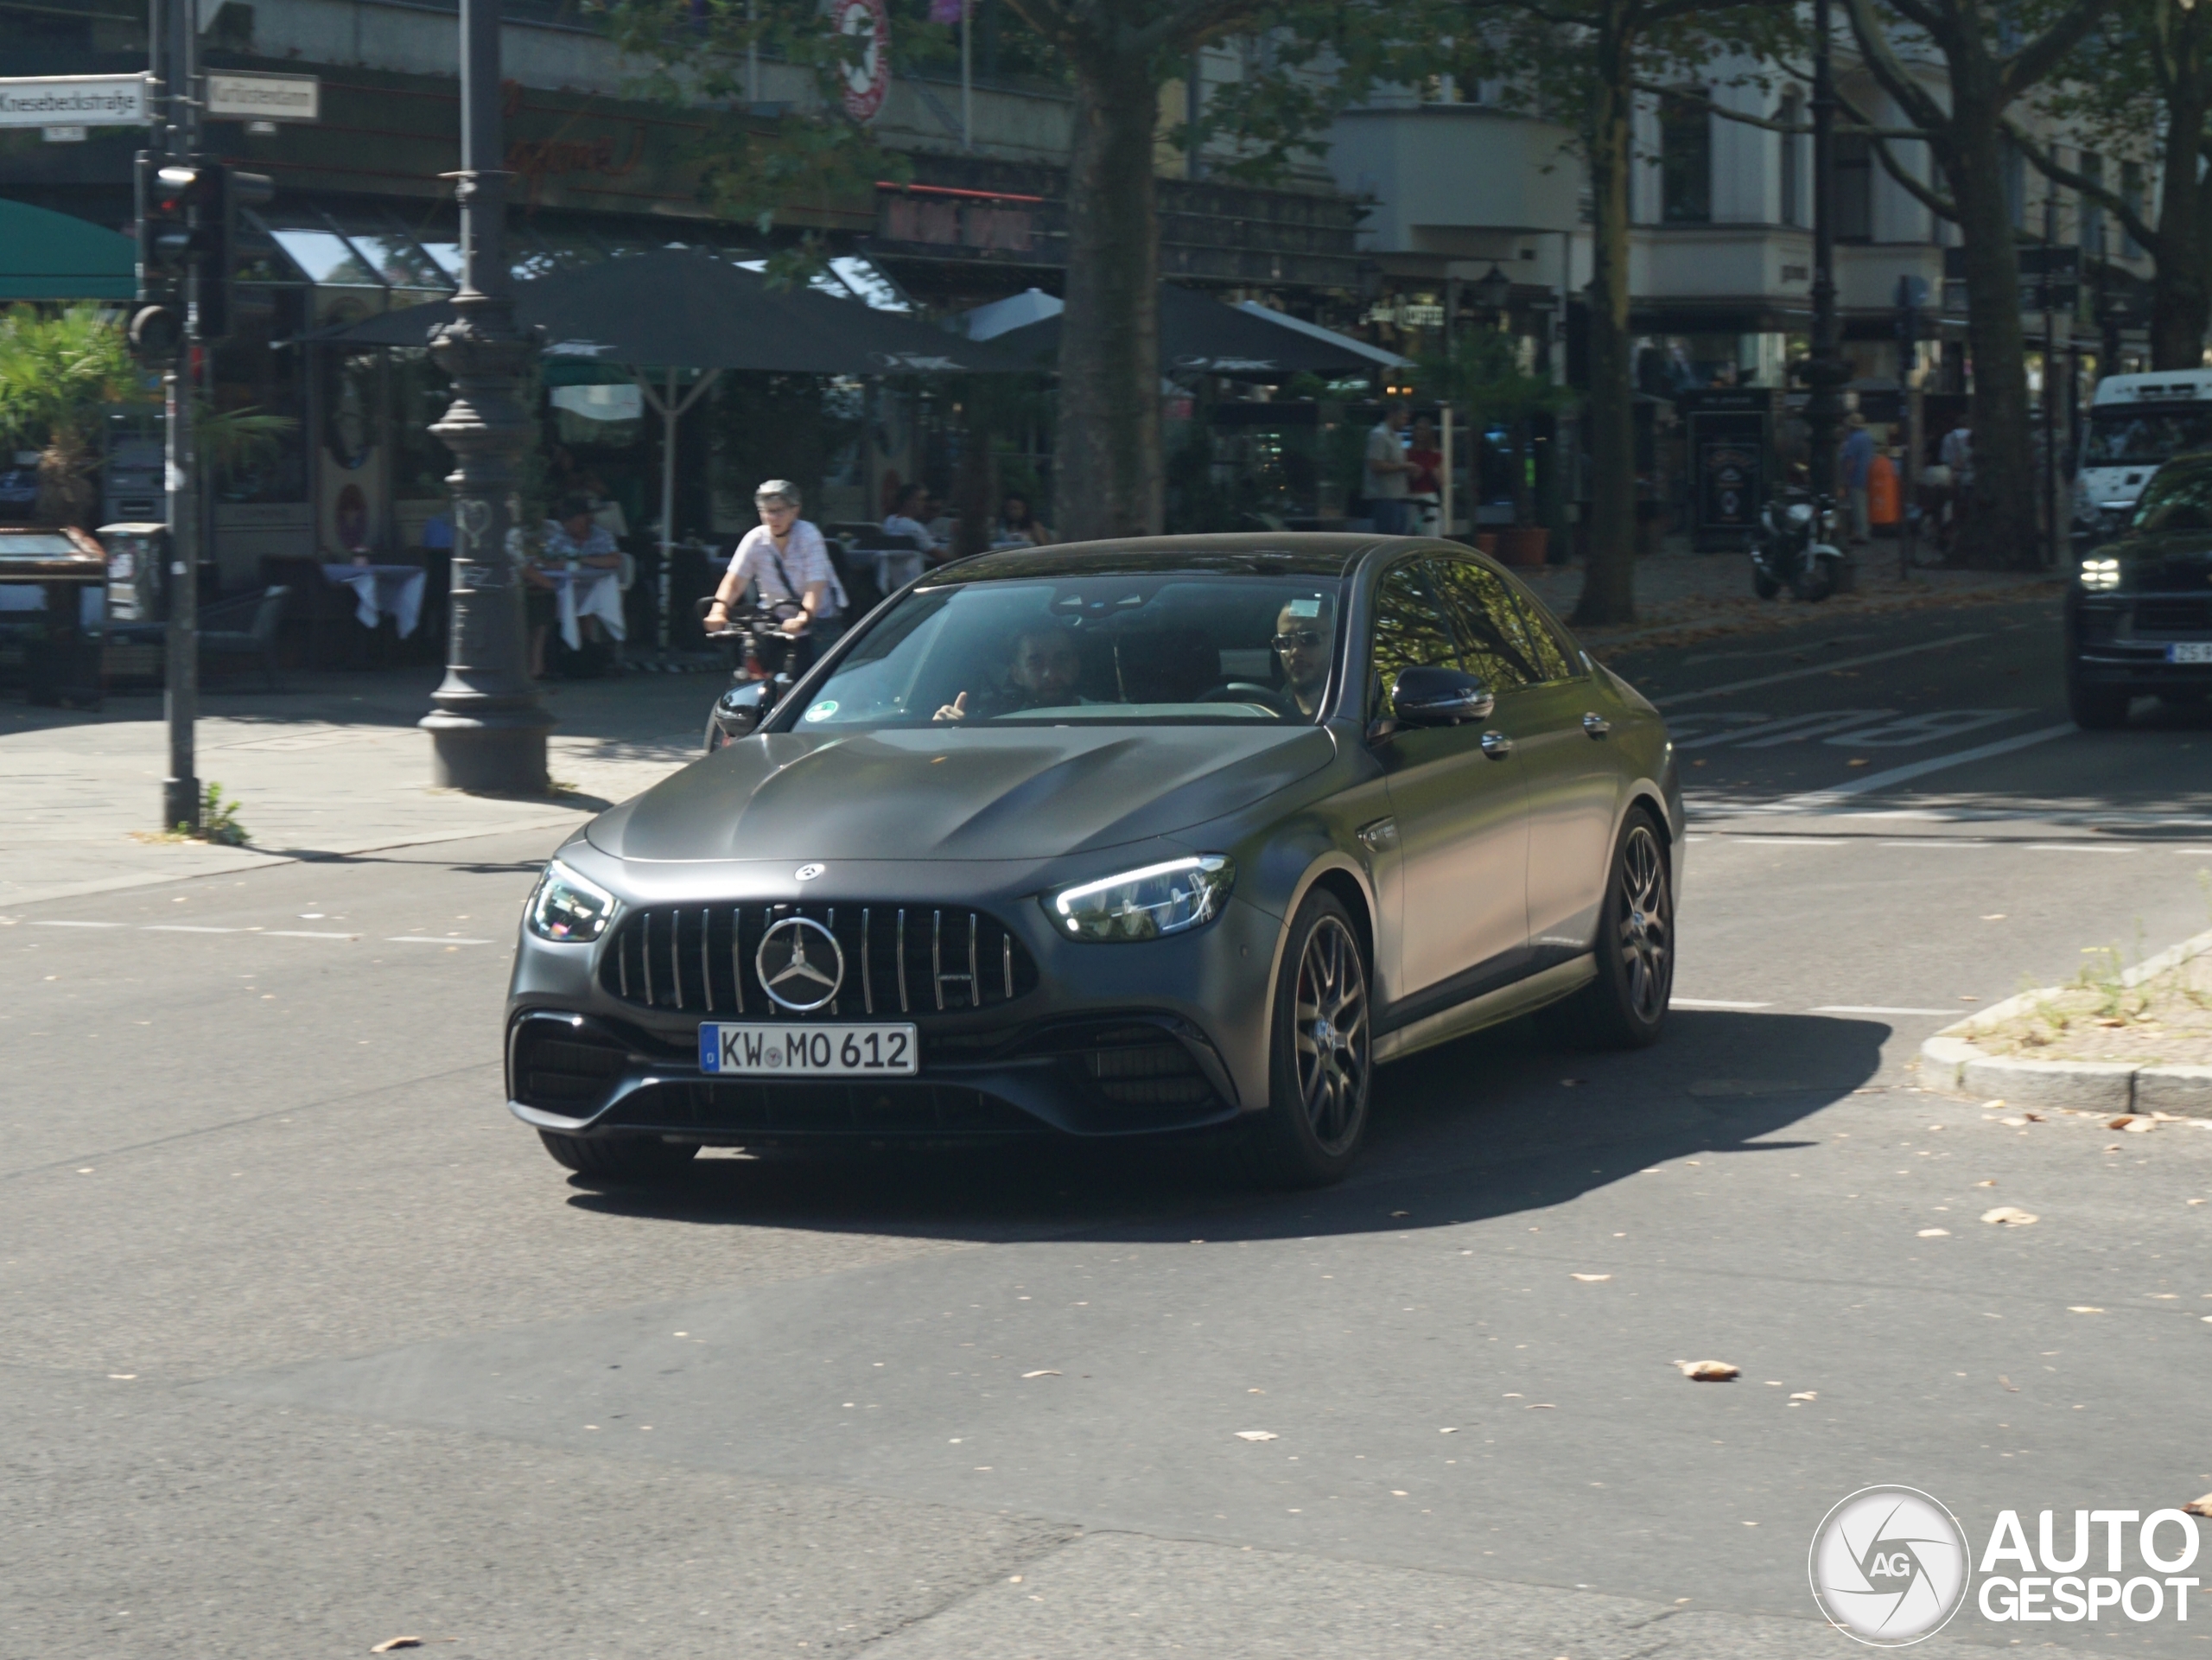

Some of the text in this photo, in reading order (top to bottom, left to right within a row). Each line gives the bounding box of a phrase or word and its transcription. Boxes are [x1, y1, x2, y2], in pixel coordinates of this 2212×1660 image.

[0, 90, 136, 115] Knesebeckstraße
[721, 1031, 908, 1068] KW MO 612
